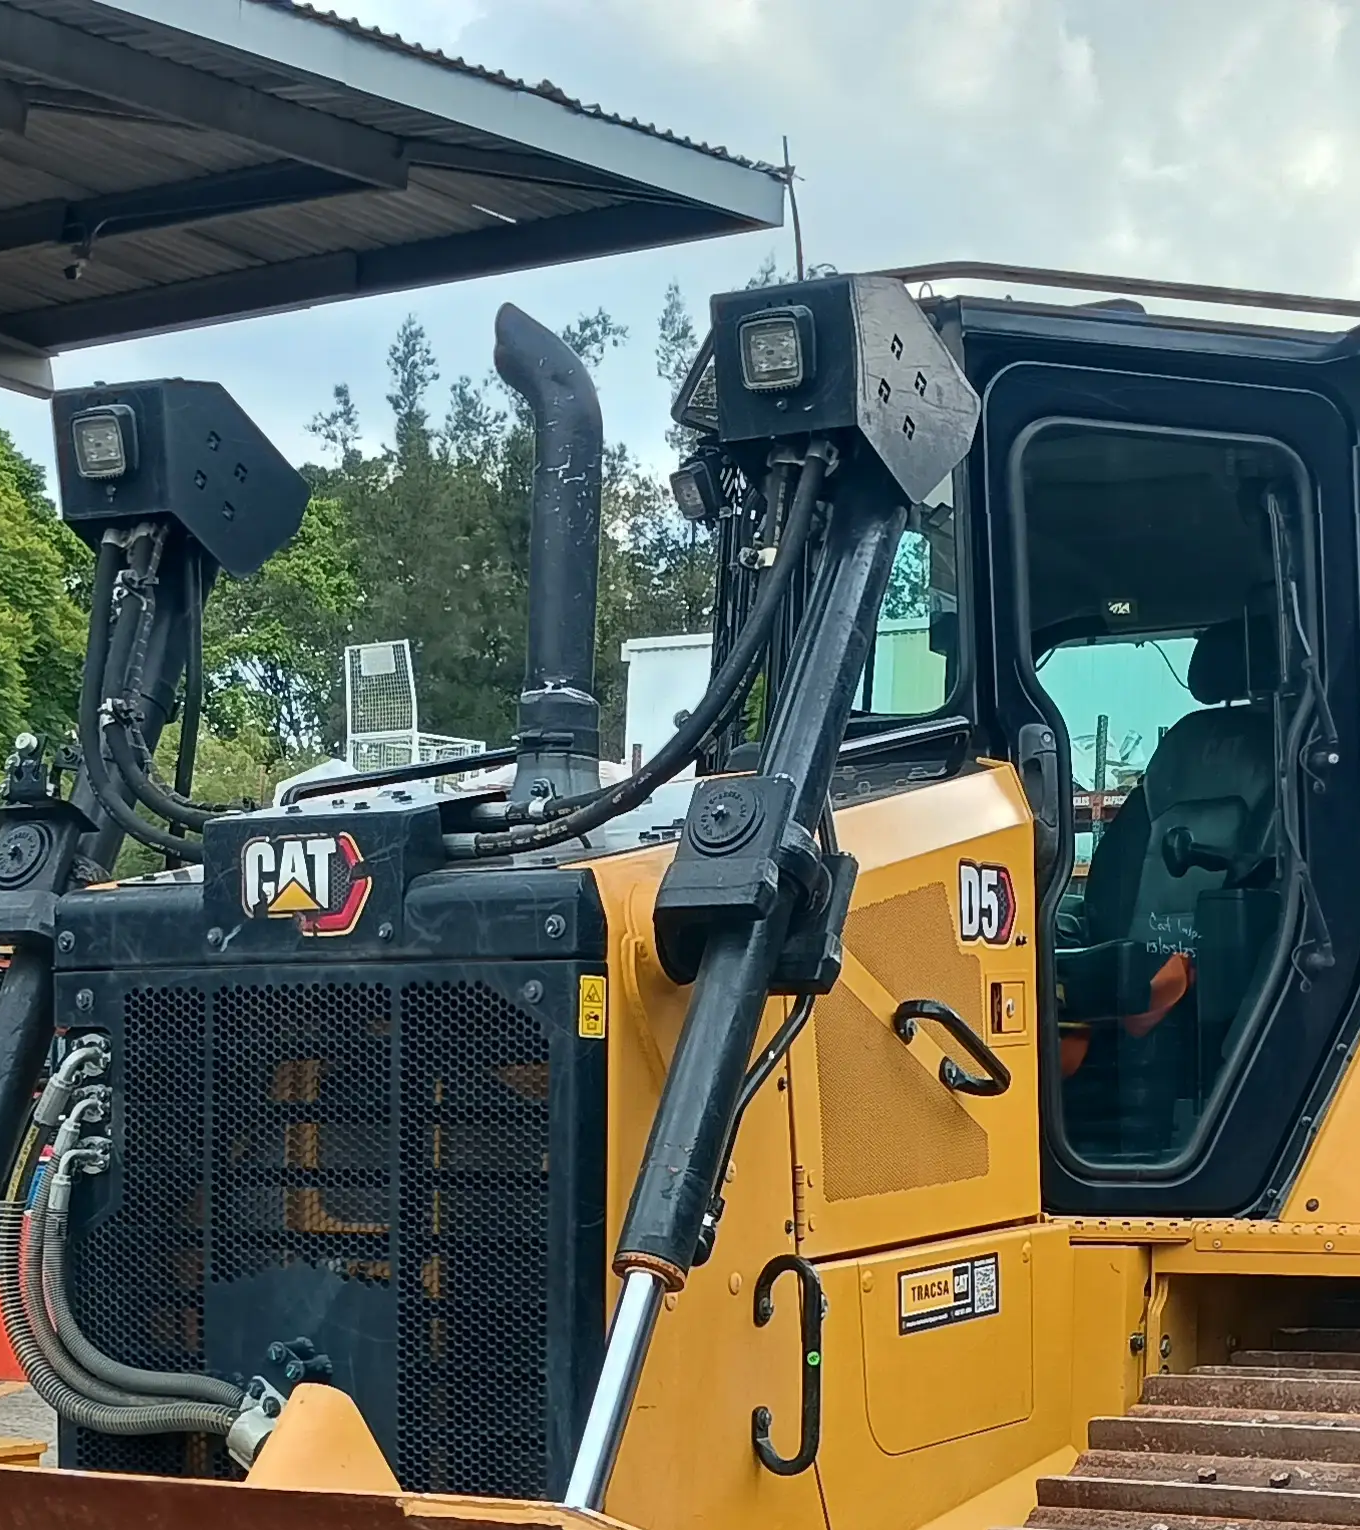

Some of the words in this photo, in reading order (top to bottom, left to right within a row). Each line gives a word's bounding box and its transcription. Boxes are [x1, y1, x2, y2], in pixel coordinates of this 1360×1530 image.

[245, 838, 337, 912] CAT
[960, 865, 999, 939] D5
[911, 1280, 950, 1302] TRACSA
